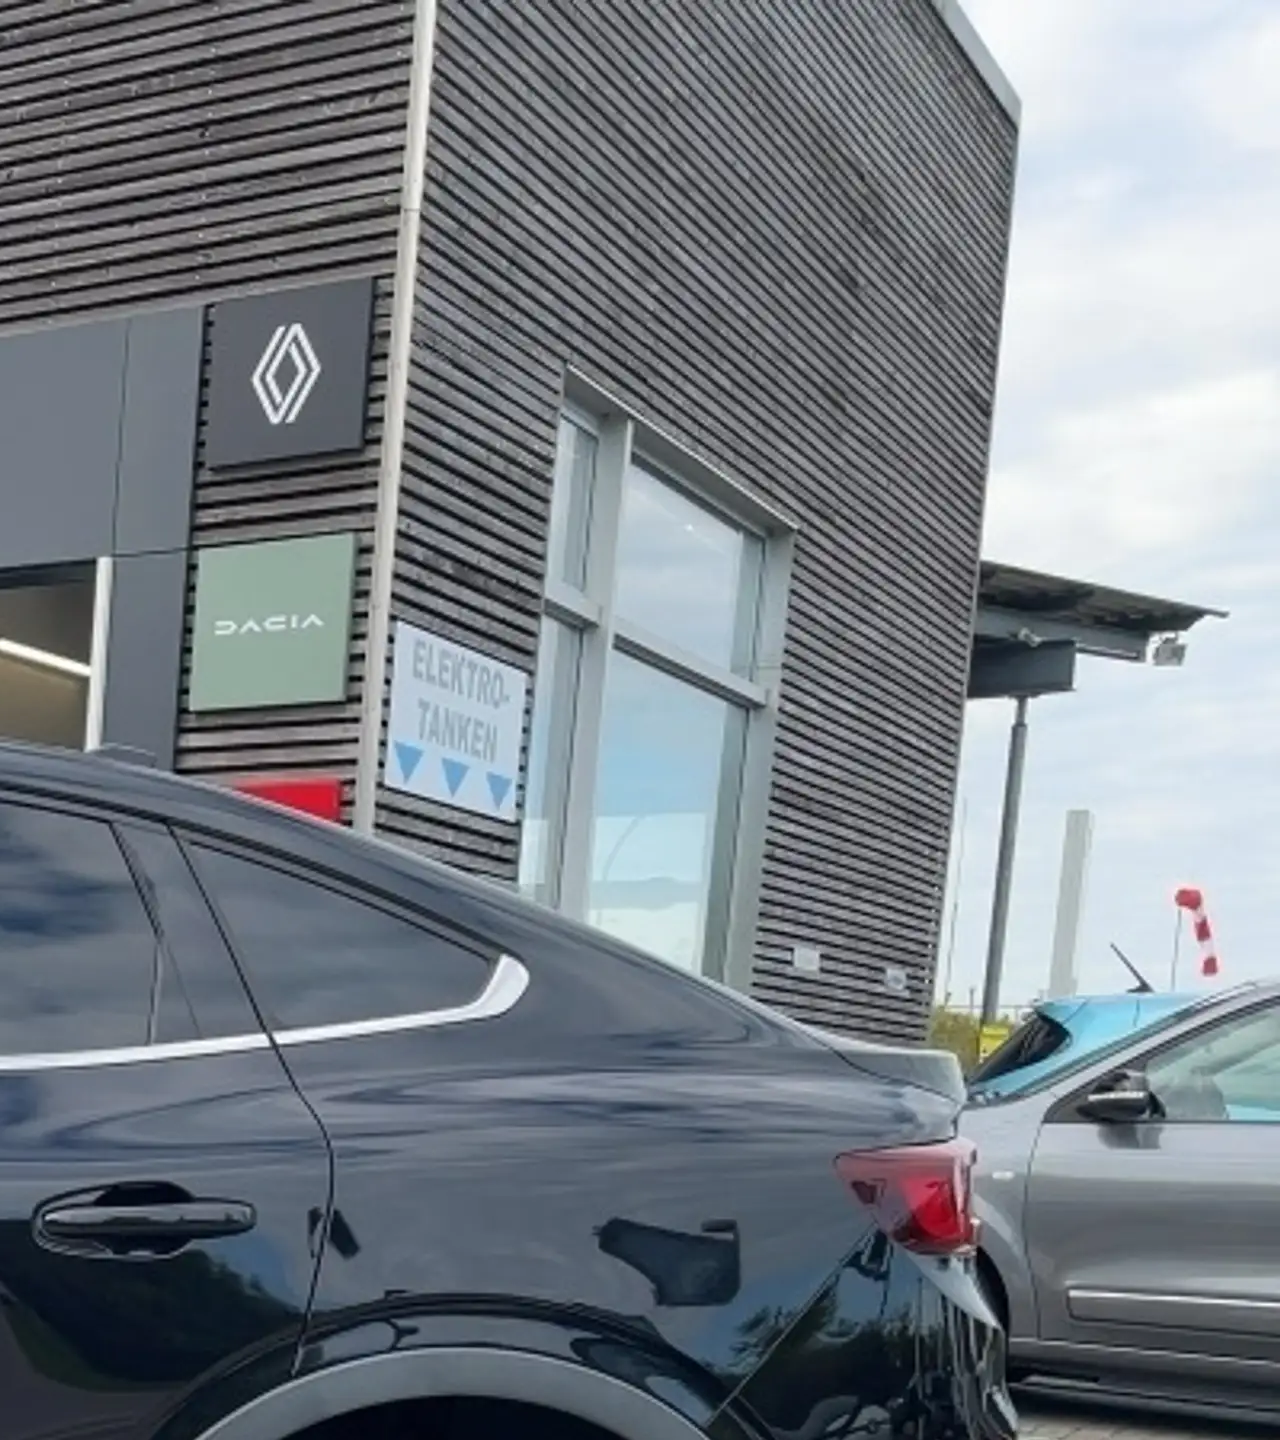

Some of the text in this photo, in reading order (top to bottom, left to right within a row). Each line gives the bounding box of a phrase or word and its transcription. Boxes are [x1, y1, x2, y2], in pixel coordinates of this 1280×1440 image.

[214, 613, 326, 636] DACIA
[412, 639, 511, 710] ELEKTRO-
[417, 698, 499, 763] TANKEN
